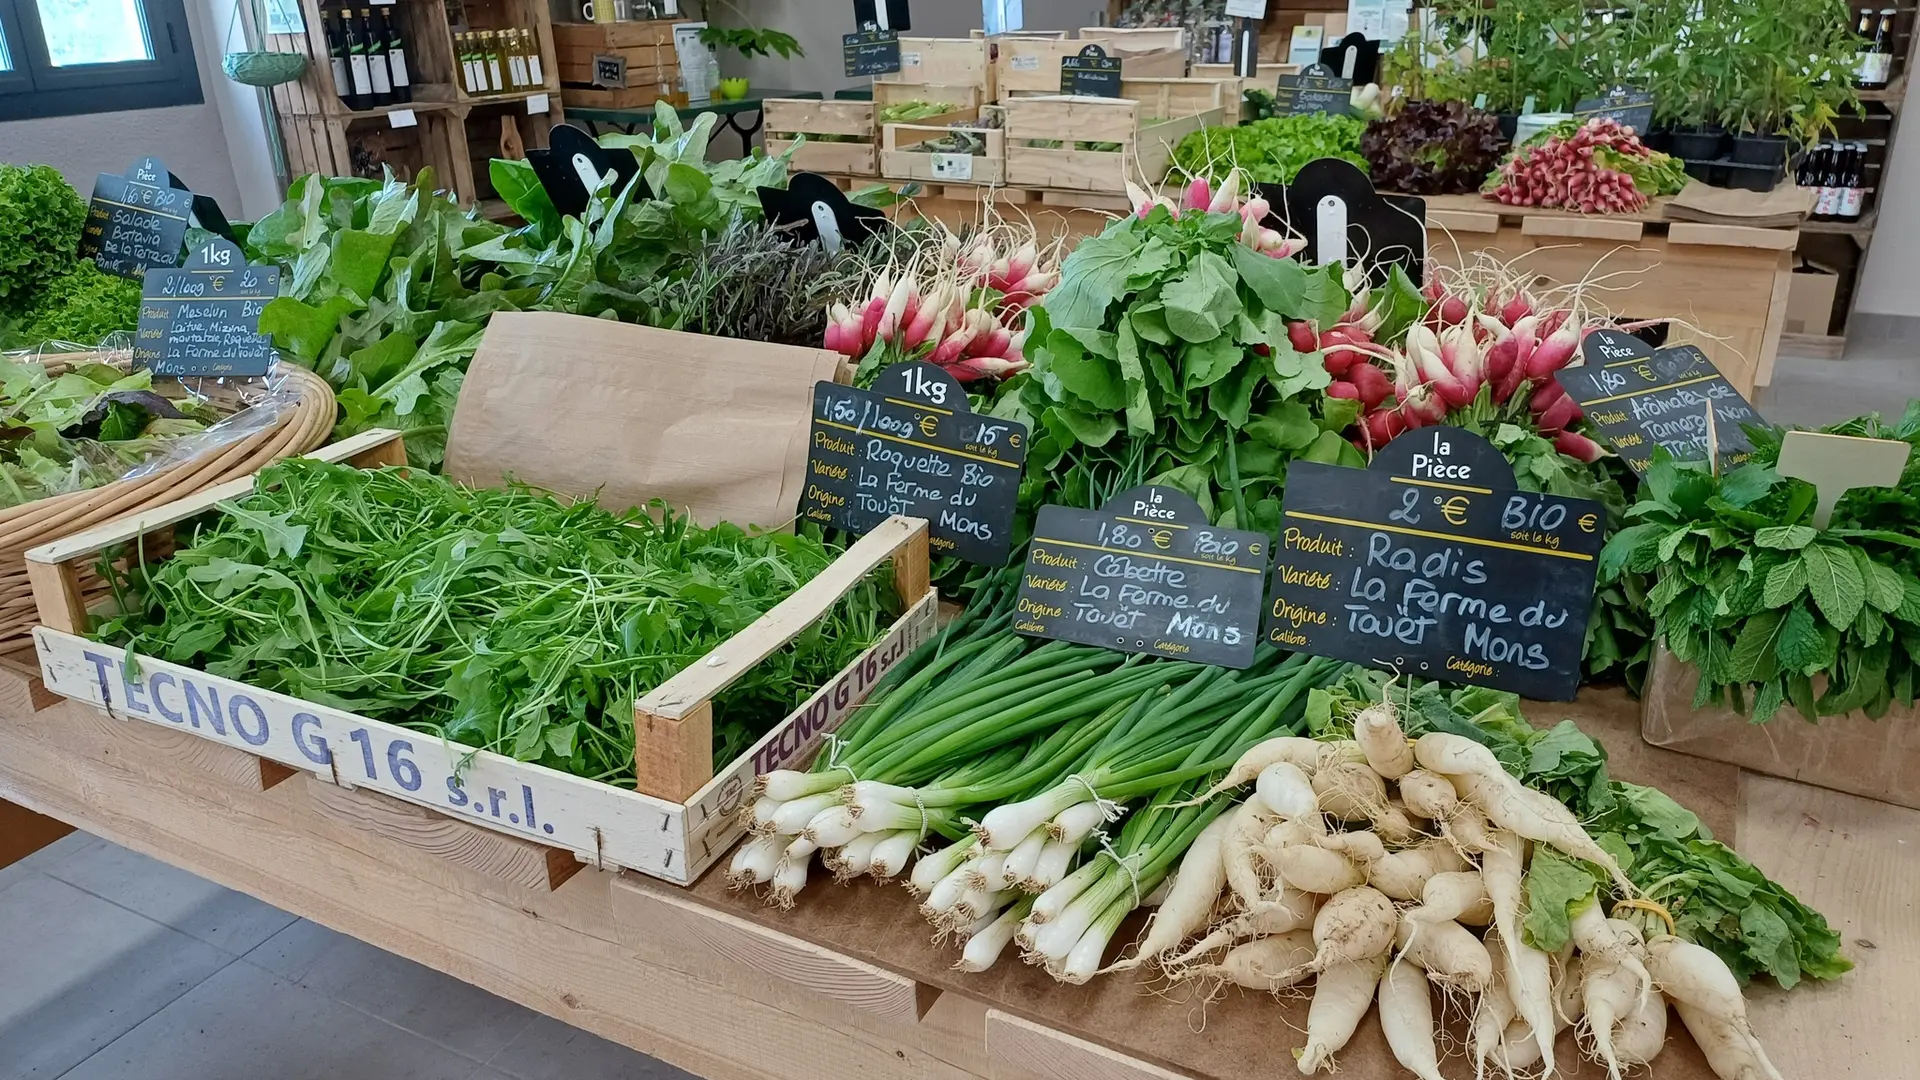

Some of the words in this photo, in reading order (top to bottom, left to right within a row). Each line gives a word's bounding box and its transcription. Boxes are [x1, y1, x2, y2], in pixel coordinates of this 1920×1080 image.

[136, 168, 157, 182] Pièce
[145, 157, 152, 170] la
[112, 208, 162, 231] Salade
[111, 225, 161, 247] Batavia
[201, 242, 231, 266] 1kg
[240, 269, 258, 288] 20
[141, 305, 169, 319] Produit
[241, 300, 263, 318] Bio
[167, 346, 180, 359] La
[184, 343, 221, 358] Ferme
[222, 346, 237, 358] du
[1598, 331, 1615, 346] la
[1599, 344, 1635, 360] Pièce
[154, 359, 186, 375] Mons
[901, 366, 948, 405] 1kg
[1589, 369, 1627, 397] 1,80
[1590, 410, 1630, 428] Produit
[1707, 382, 1737, 401] de
[1715, 404, 1752, 423] Non
[919, 415, 940, 438] €
[975, 422, 1009, 446] 15
[1008, 433, 1022, 448] €
[1432, 430, 1451, 457] la
[814, 431, 855, 456] Produit
[865, 439, 953, 478] Roquette
[960, 463, 994, 487] Bio
[1411, 453, 1472, 481] Pièce
[811, 458, 849, 481] Variété
[857, 466, 878, 488] La
[886, 471, 943, 502] Ferme
[949, 487, 977, 507] du
[1150, 487, 1164, 504] la
[807, 484, 846, 508] Origine
[939, 509, 993, 541] Mons
[1132, 500, 1176, 521] Pièce
[1388, 487, 1421, 525] 2
[1440, 495, 1471, 526] €
[1577, 513, 1598, 533] €
[1097, 521, 1142, 550] 1,80
[1151, 530, 1174, 549] €
[1248, 542, 1262, 556] €
[1510, 530, 1530, 541] soit
[1532, 530, 1543, 543] le
[1544, 532, 1560, 550] kg
[1031, 548, 1079, 570] Produit
[1283, 526, 1344, 557] Produit
[1366, 531, 1488, 585] Radis
[1025, 573, 1068, 594] Variété
[1080, 574, 1110, 600] La
[1118, 583, 1195, 610] Ferme
[1196, 594, 1231, 615] du
[1277, 564, 1332, 590] Variété
[1349, 565, 1386, 602] La
[1402, 577, 1512, 624] Ferme
[1518, 600, 1570, 629] du
[1018, 597, 1063, 620] Origine
[1165, 611, 1241, 646] Mons
[1272, 597, 1327, 629] Origine
[1464, 622, 1551, 670] Mons
[1014, 619, 1046, 634] Calibre
[1153, 638, 1190, 656] Catégorie
[1270, 627, 1307, 646] Calibre
[1445, 655, 1494, 678] Catégorie
[750, 694, 830, 777] TECNO
[834, 673, 850, 711] G
[855, 648, 878, 692] 16
[84, 650, 270, 746] TECNO
[291, 712, 333, 766] G
[349, 728, 423, 793] 16
[446, 774, 556, 835] s.r.l.
